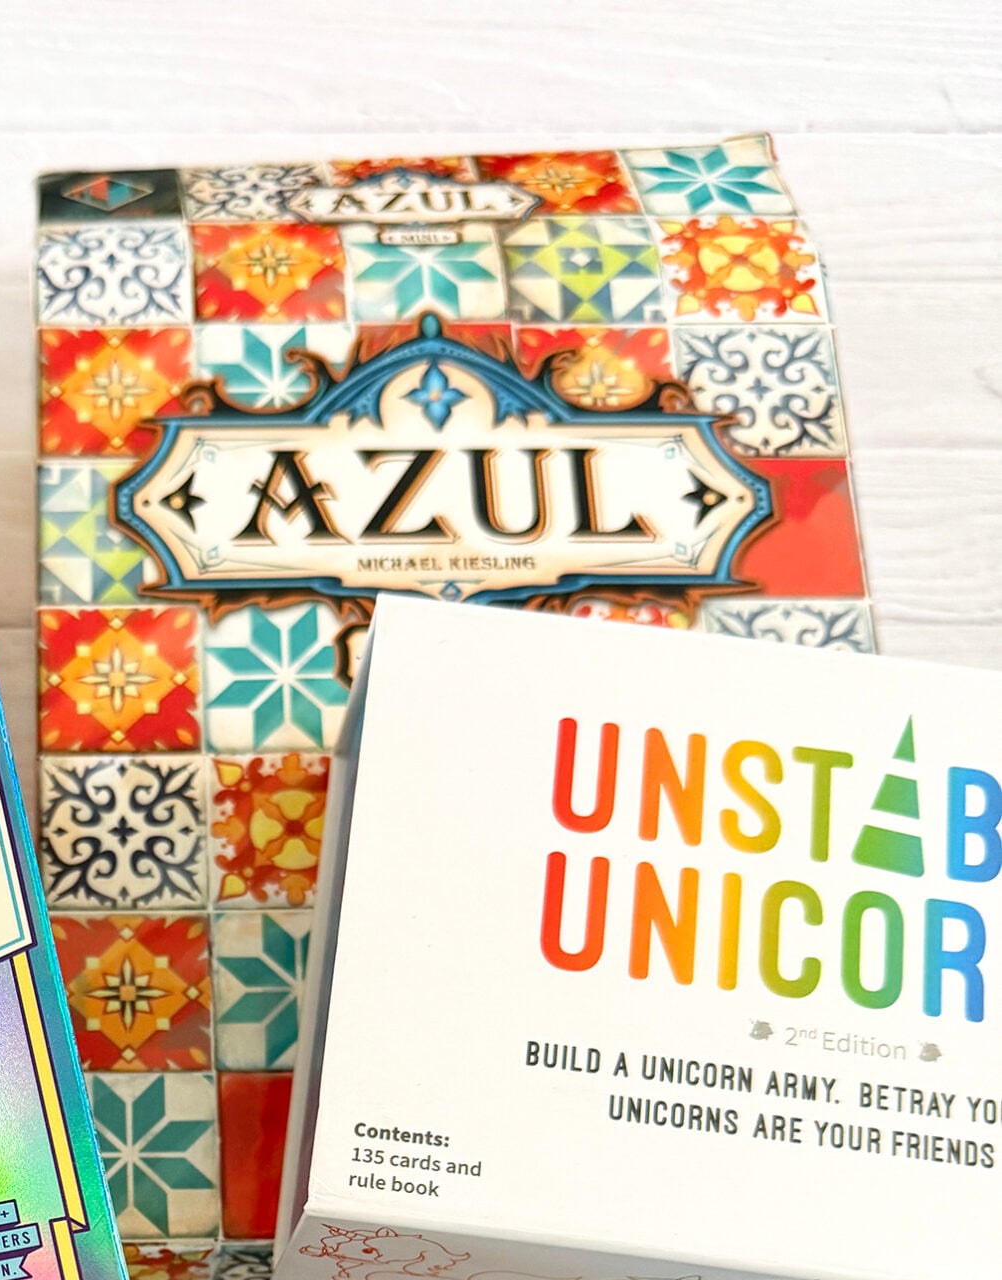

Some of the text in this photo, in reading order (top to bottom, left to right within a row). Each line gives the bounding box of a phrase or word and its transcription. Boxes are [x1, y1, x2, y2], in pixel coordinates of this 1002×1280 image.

[330, 191, 498, 214] AZUL
[232, 448, 662, 546] AZUL
[357, 555, 536, 572] MICHAEL KIESLING
[539, 850, 986, 1023] UNICOR
[784, 1026, 907, 1061] 2nd Edition
[525, 1041, 1002, 1125] BUILD A UNICORN ARMY. BETRAY YO
[354, 1121, 450, 1149] Contents:
[608, 1095, 996, 1169] UNICORNS ARE YOUR FRIENDS
[351, 1147, 483, 1178] 135 cards and
[348, 1171, 440, 1198] rule book
